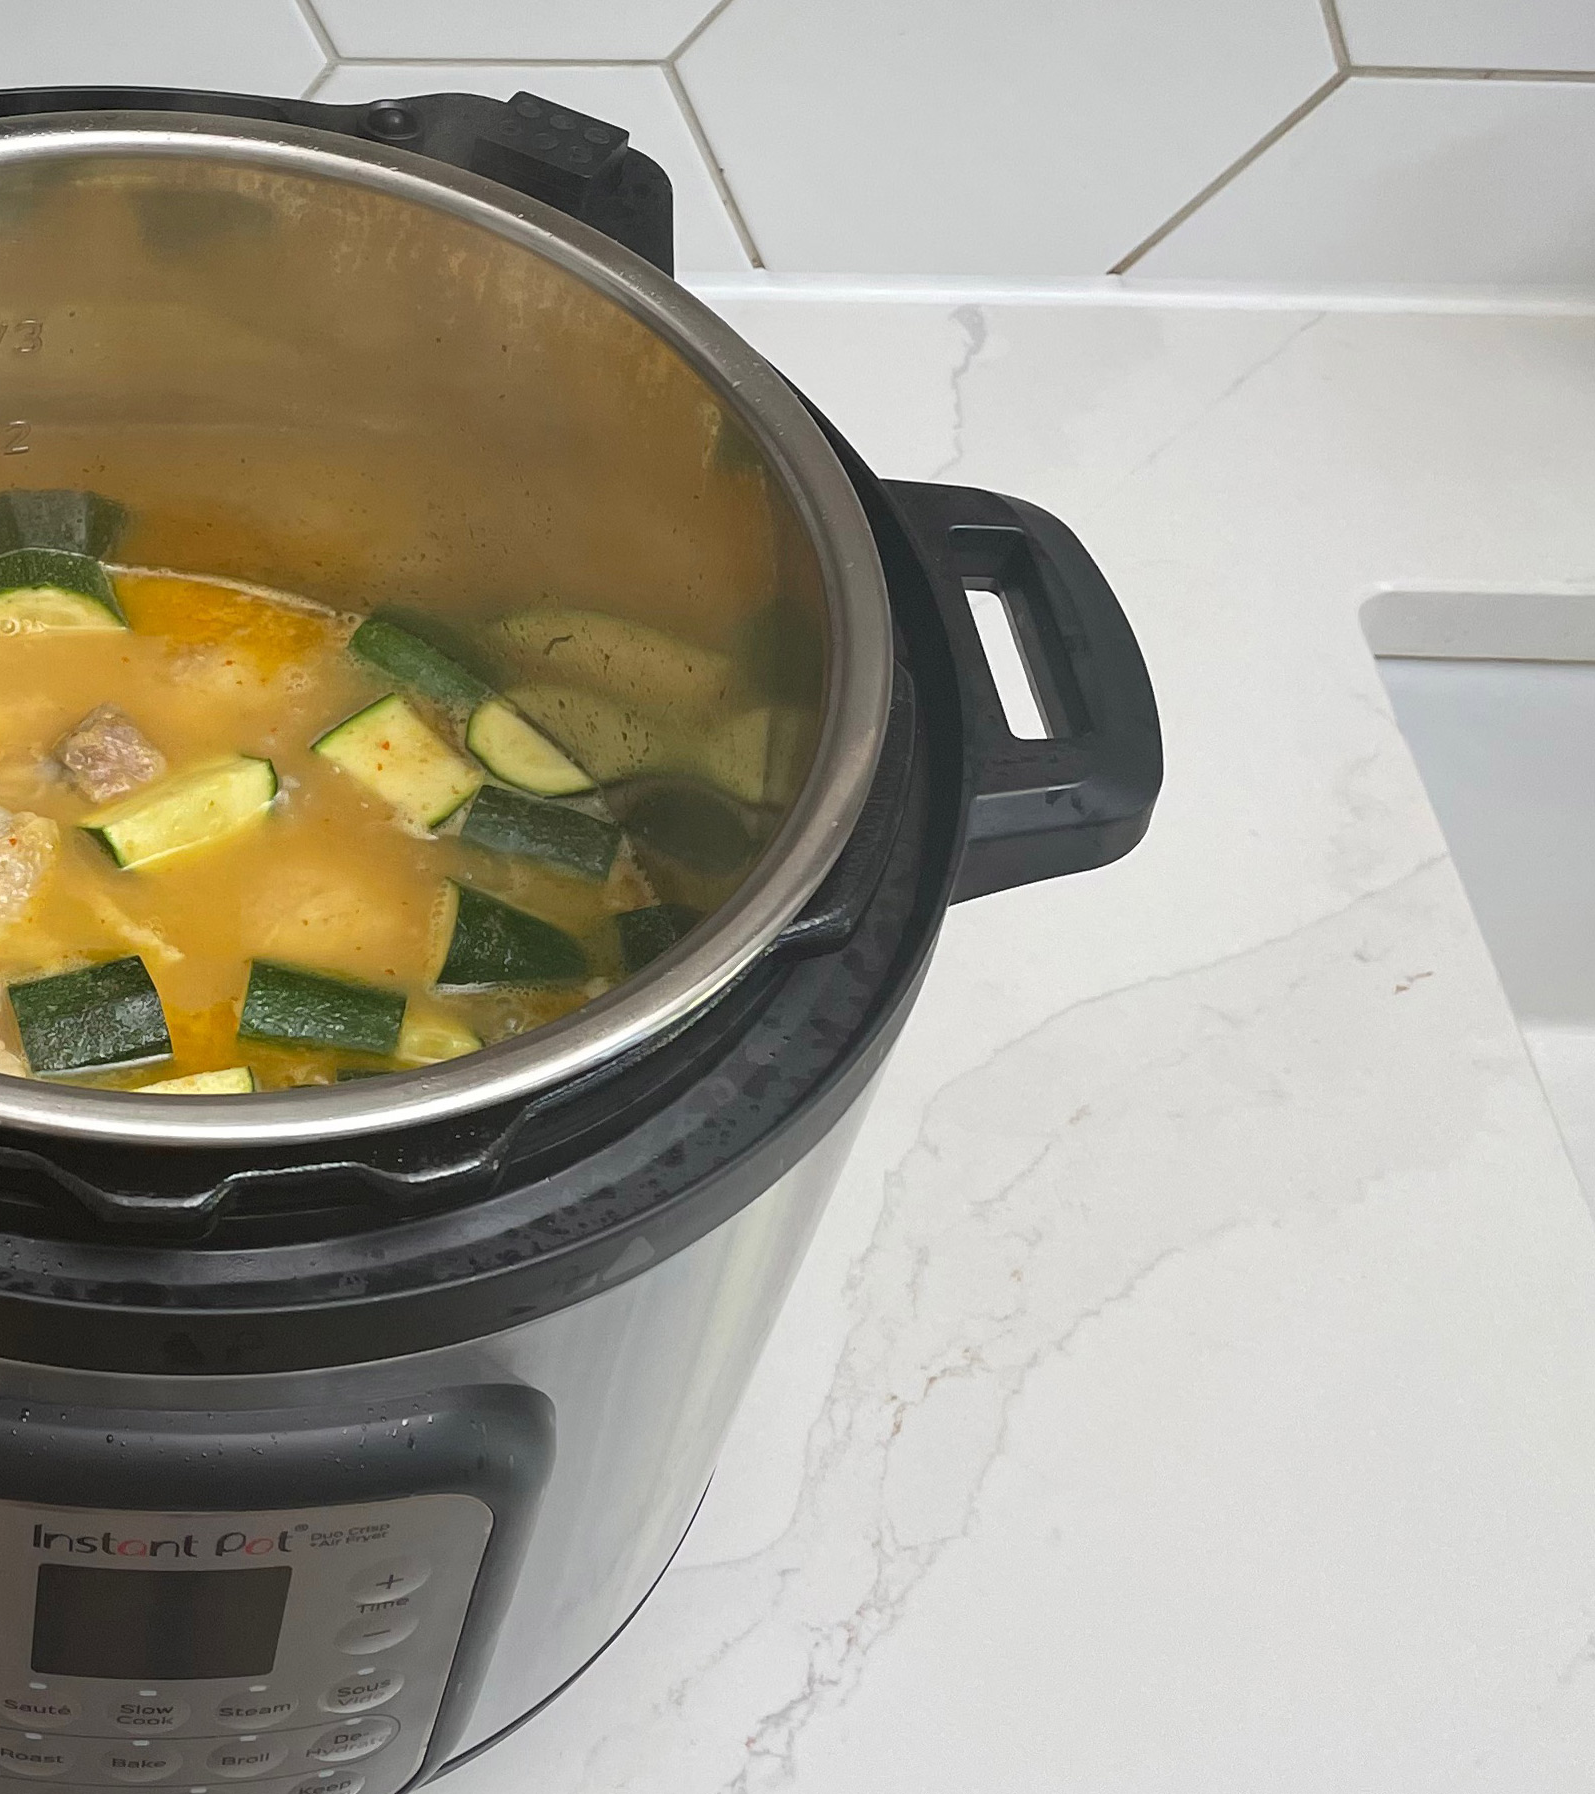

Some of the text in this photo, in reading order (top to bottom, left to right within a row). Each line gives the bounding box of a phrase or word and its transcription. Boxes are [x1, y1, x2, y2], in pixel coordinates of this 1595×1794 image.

[310, 1523, 391, 1541] Duo Crisp
[345, 1531, 390, 1544] Fryer
[32, 1523, 199, 1558] Instant
[356, 1598, 410, 1614] Time
[337, 1678, 392, 1698] Sous
[338, 1691, 386, 1706] Vide
[120, 1703, 175, 1715] Slow
[219, 1702, 292, 1718] Steam
[116, 1715, 175, 1726] Cook
[0, 1747, 65, 1765] Roast
[111, 1757, 167, 1769] Bake
[221, 1752, 271, 1766] Broil
[297, 1779, 353, 1794] Keep
